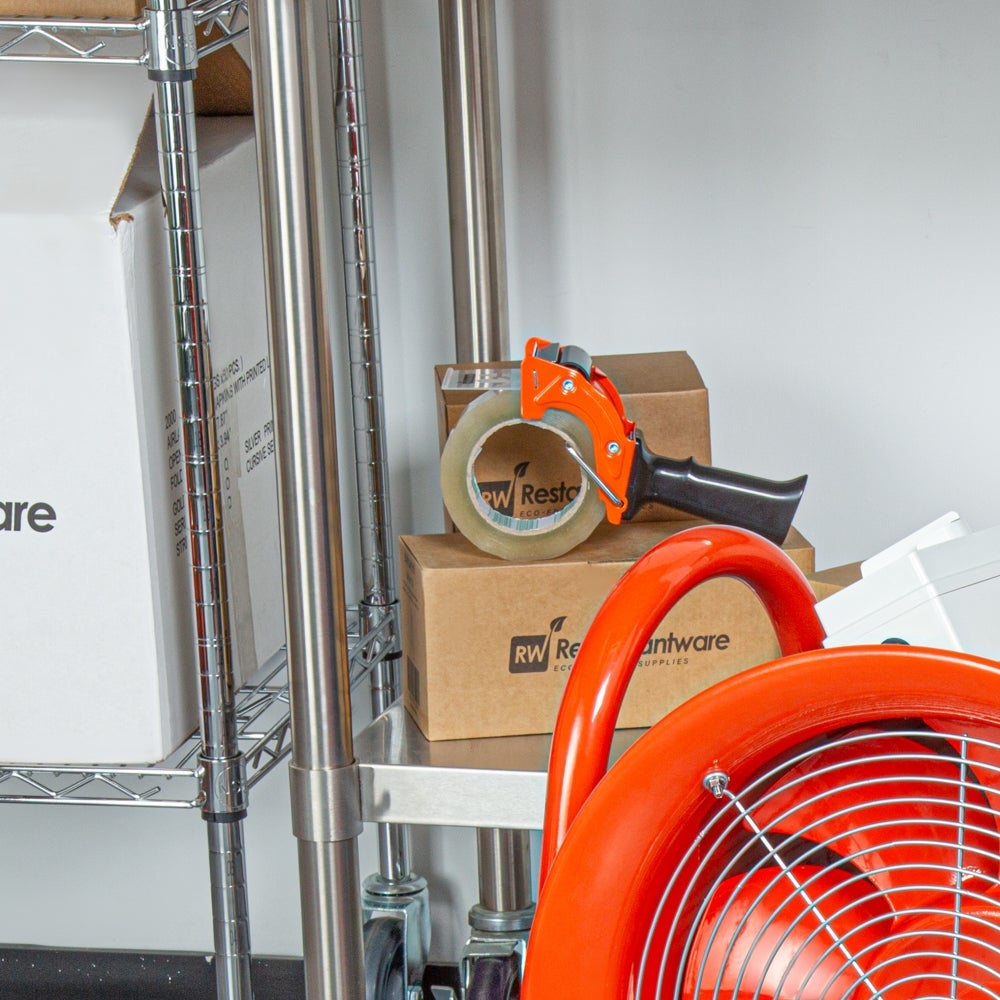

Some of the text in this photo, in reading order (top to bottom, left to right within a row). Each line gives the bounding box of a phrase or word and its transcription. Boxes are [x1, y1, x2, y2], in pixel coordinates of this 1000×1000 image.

[244, 429, 262, 454] SILVER
[246, 445, 267, 473] CURSIVE
[638, 658, 689, 668] SUPPLIES
